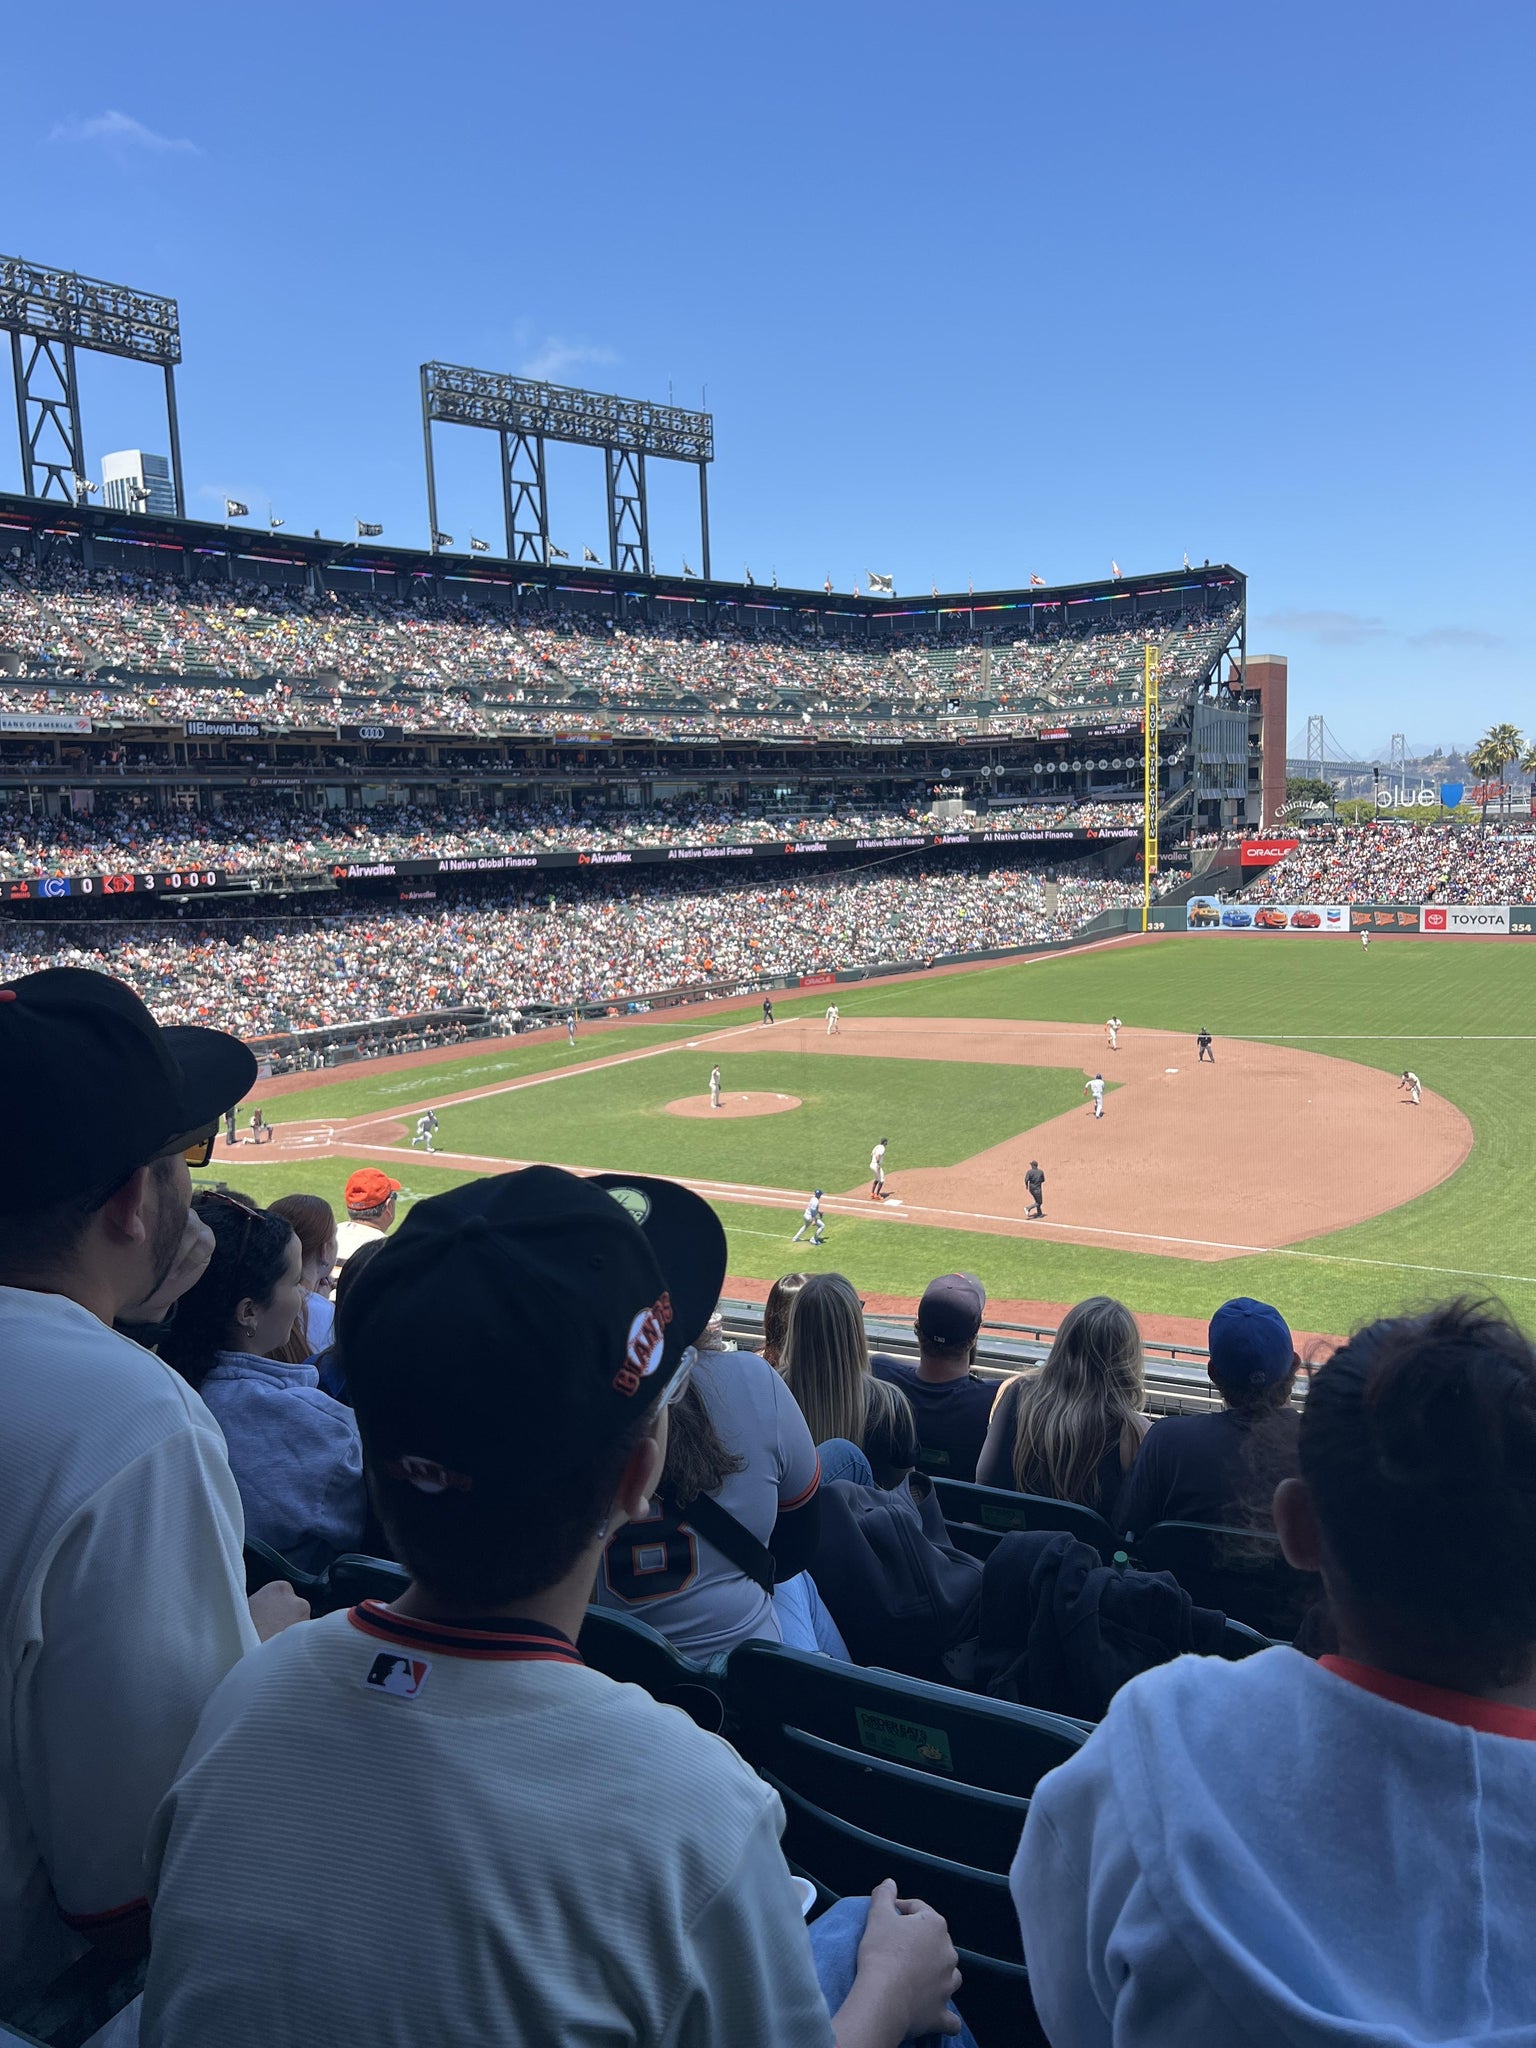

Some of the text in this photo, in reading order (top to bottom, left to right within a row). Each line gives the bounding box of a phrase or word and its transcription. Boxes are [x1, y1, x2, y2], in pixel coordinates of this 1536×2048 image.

[38, 721, 73, 729] AMERICA
[984, 830, 1073, 841] AI Native Global Finance
[1098, 828, 1138, 838] Airwallex
[856, 837, 925, 849] AI Native Global Finance
[942, 835, 970, 844] Airwallex
[668, 846, 753, 859] AI Native Global Finance
[795, 842, 827, 853] Airwallex
[1246, 848, 1292, 857] ORACLE
[591, 852, 632, 864] Airwallex
[439, 857, 538, 872] AI Native Global Finance
[348, 864, 396, 878] Airwallex
[20, 880, 29, 892] 6
[82, 878, 93, 894] 0
[144, 874, 155, 889] 3
[172, 873, 181, 888] 0
[190, 872, 199, 887] 0
[207, 871, 216, 886] 0
[409, 890, 437, 899] Airwallex
[1452, 914, 1505, 925] TOYOTA
[1147, 922, 1165, 930] 339
[1511, 924, 1532, 932] 354
